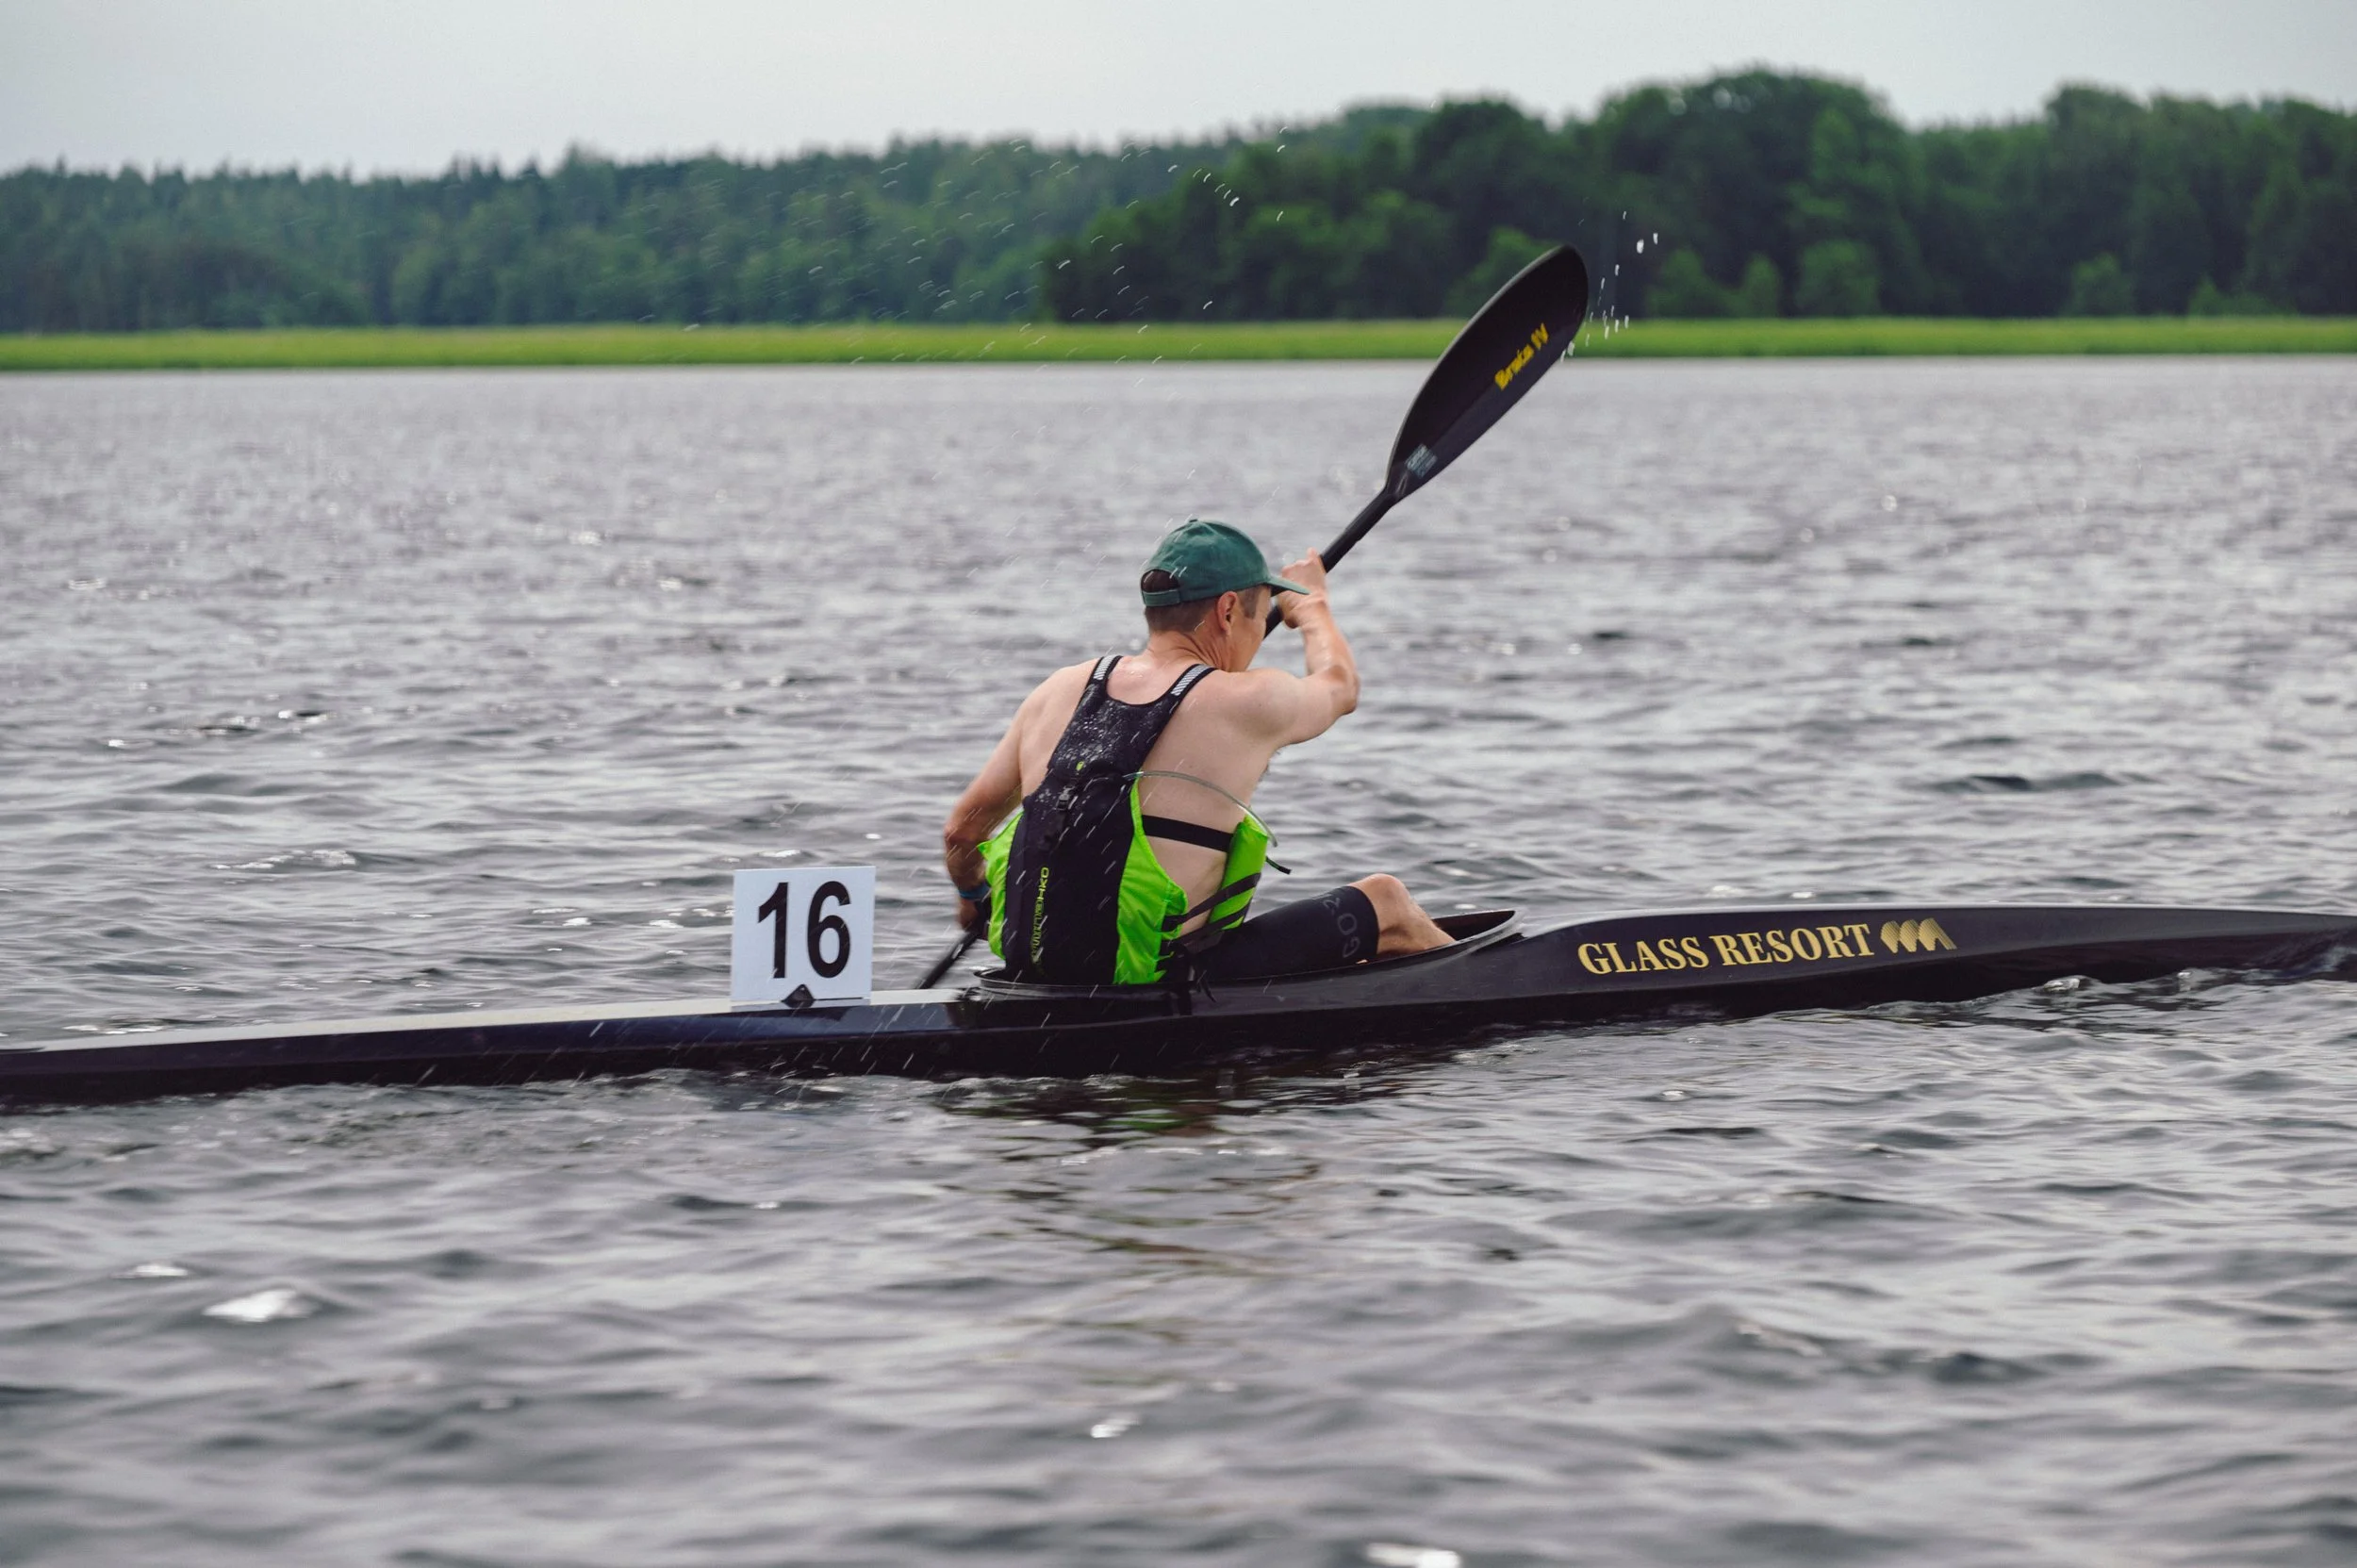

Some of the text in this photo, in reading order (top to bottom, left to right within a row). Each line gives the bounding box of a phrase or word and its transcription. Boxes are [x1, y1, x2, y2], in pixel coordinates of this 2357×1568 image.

[758, 881, 851, 978] 16
[1577, 923, 1874, 975] GLASS RESORT
